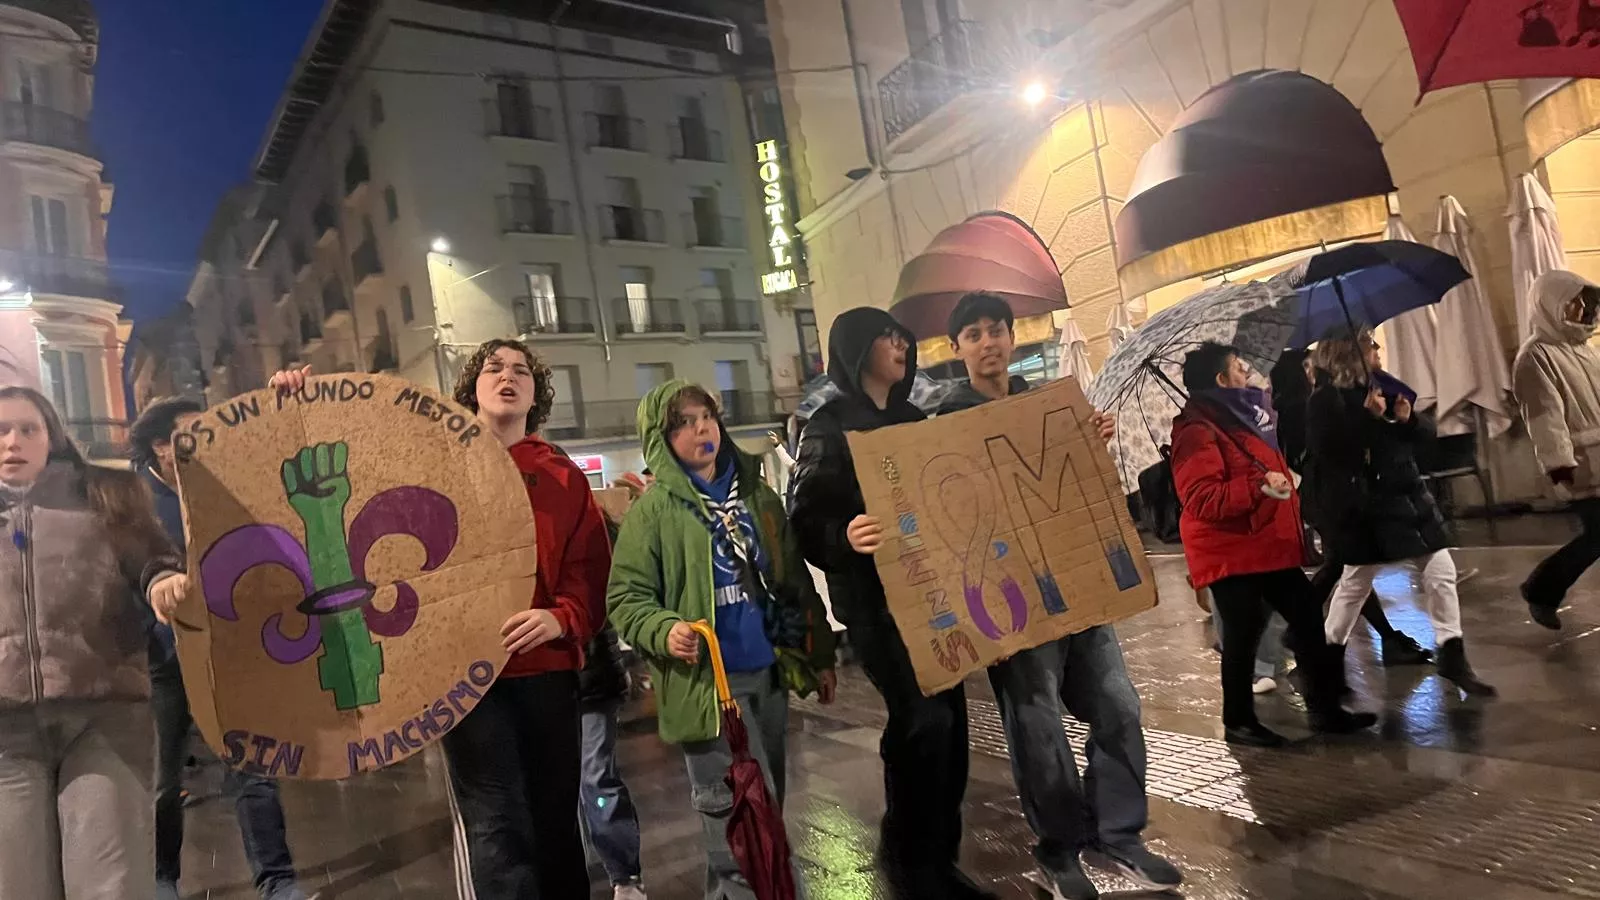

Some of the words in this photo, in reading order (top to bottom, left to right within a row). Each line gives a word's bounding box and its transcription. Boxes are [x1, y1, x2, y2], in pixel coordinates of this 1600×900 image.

[755, 139, 791, 267] HOSTAL
[216, 397, 260, 427] UN
[276, 378, 374, 410] MUNDO
[395, 387, 481, 448] MEJOR
[223, 729, 304, 776] SIN
